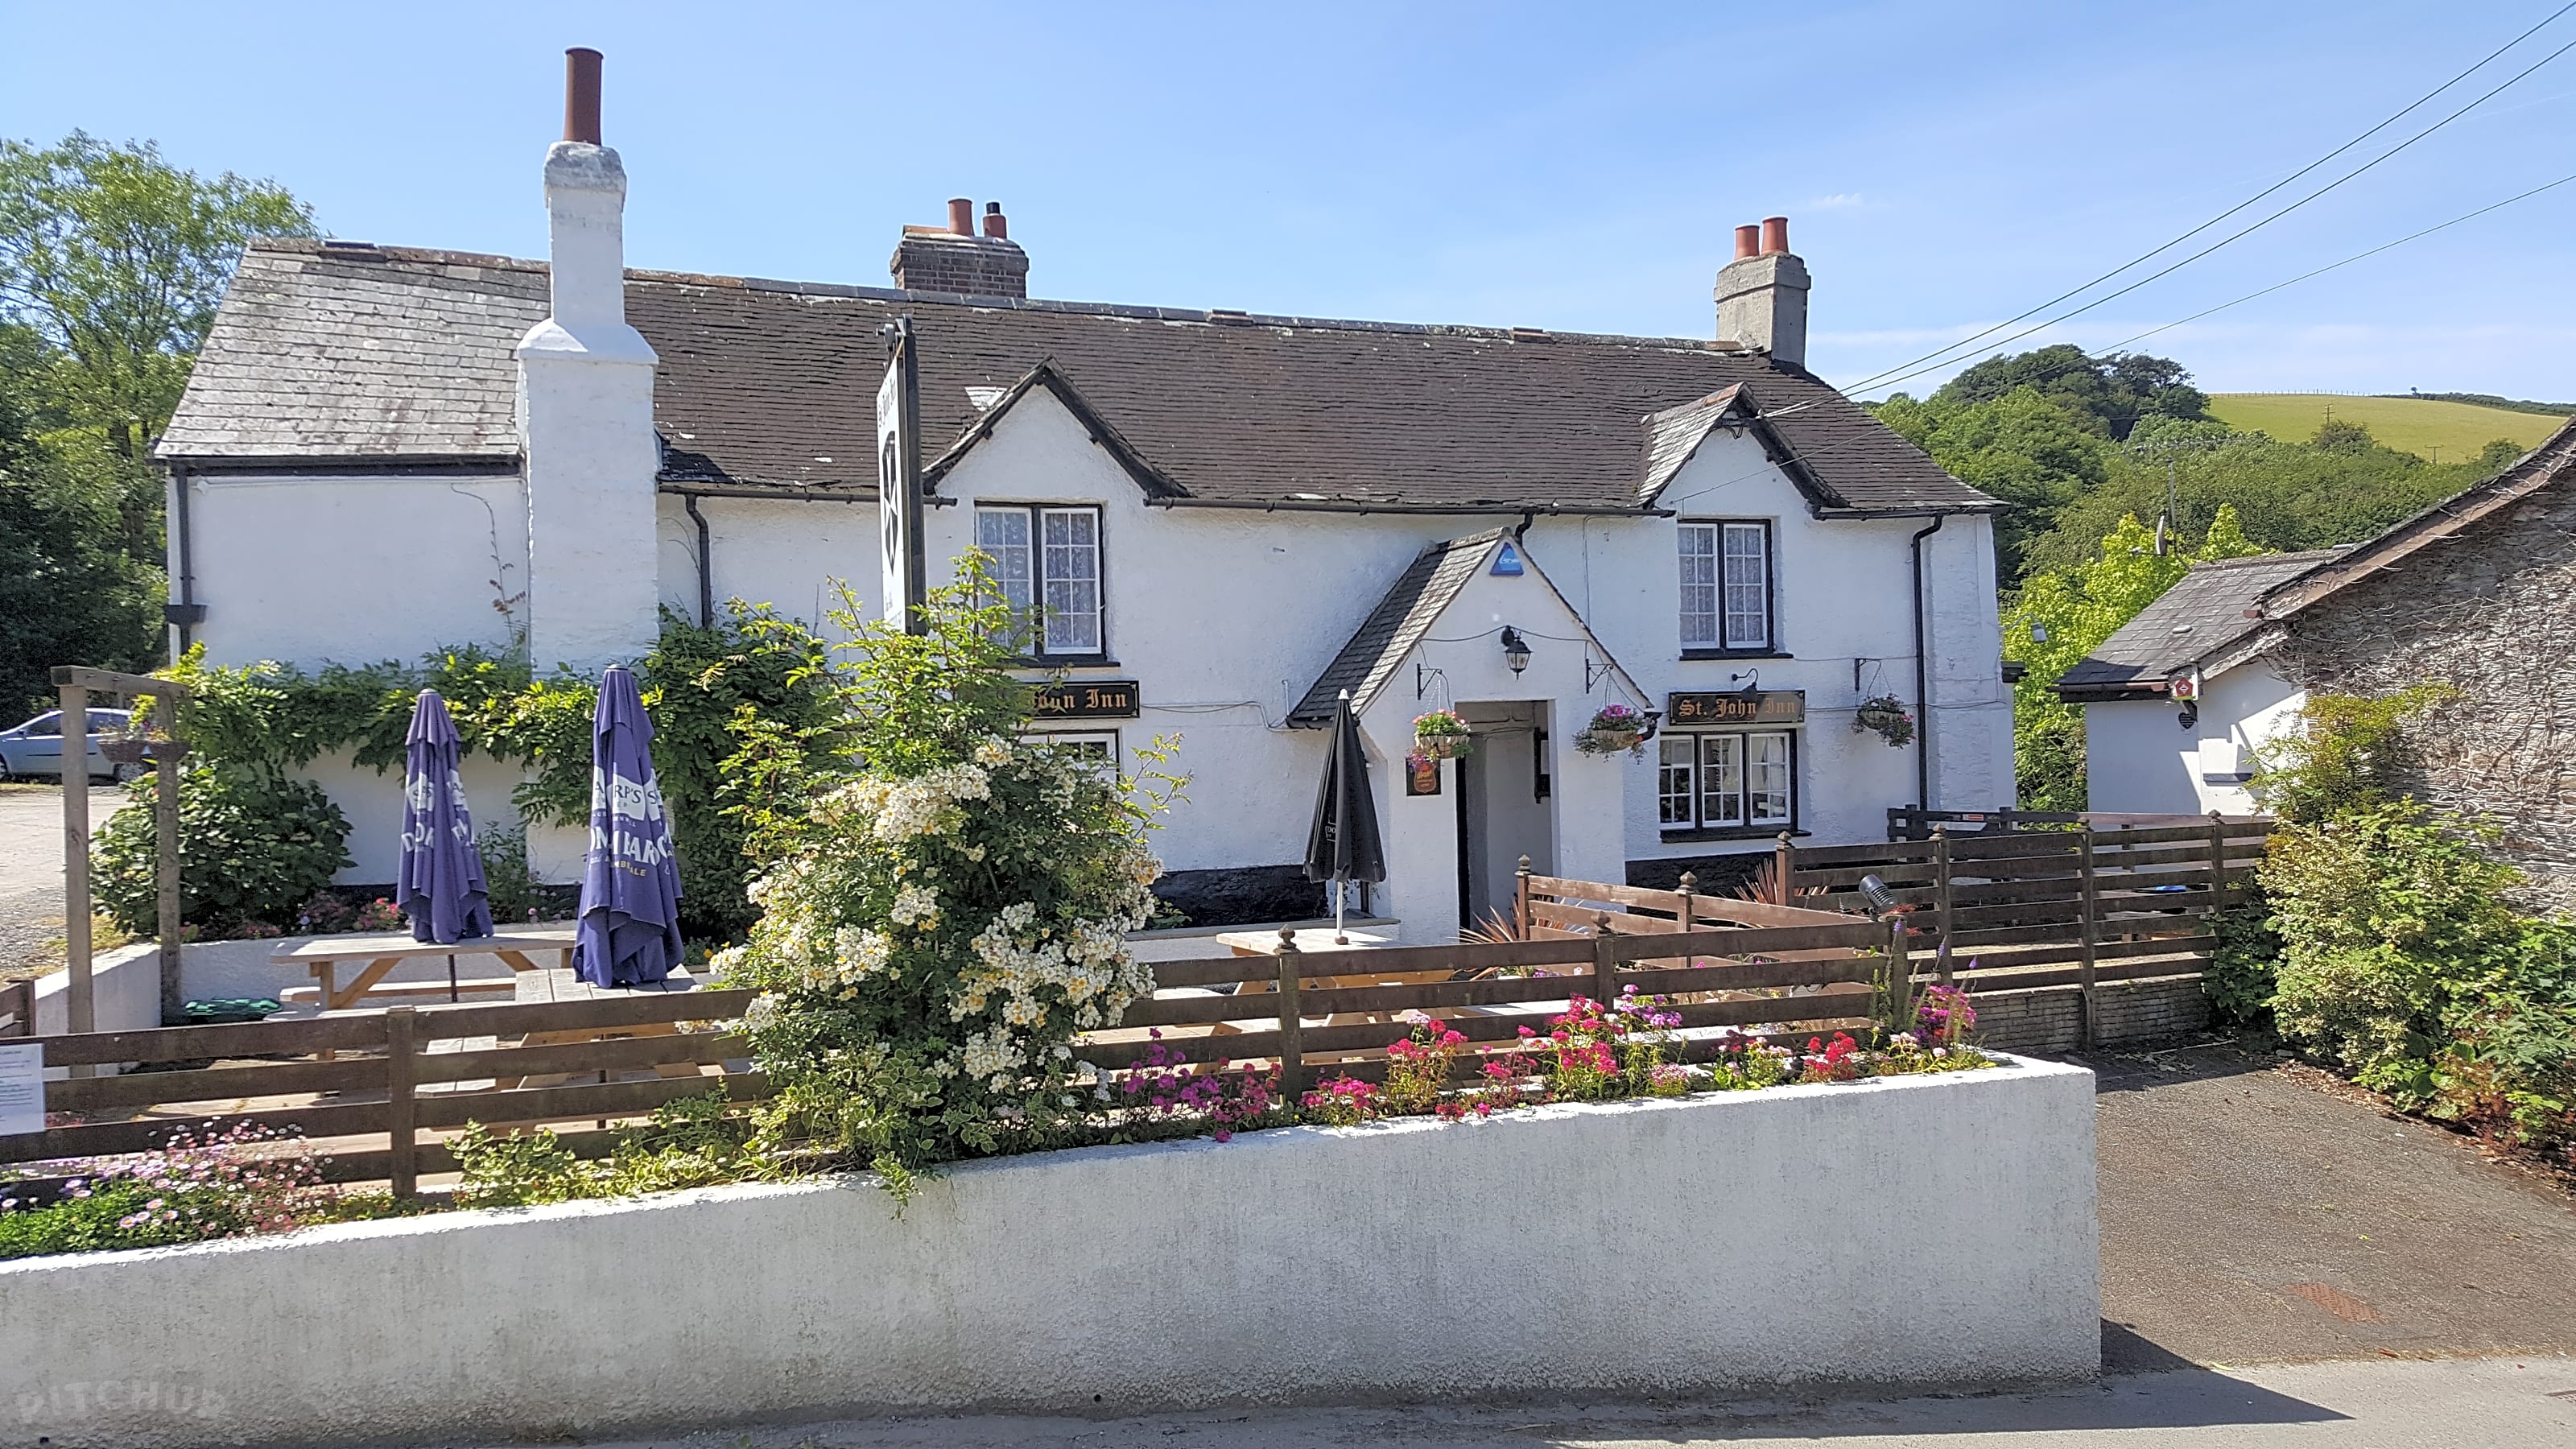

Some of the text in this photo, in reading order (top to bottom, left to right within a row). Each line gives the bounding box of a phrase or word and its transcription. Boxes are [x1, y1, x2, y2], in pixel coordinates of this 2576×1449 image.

[1085, 688, 1127, 709] Inn
[1678, 697, 1796, 718] St. John Inn
